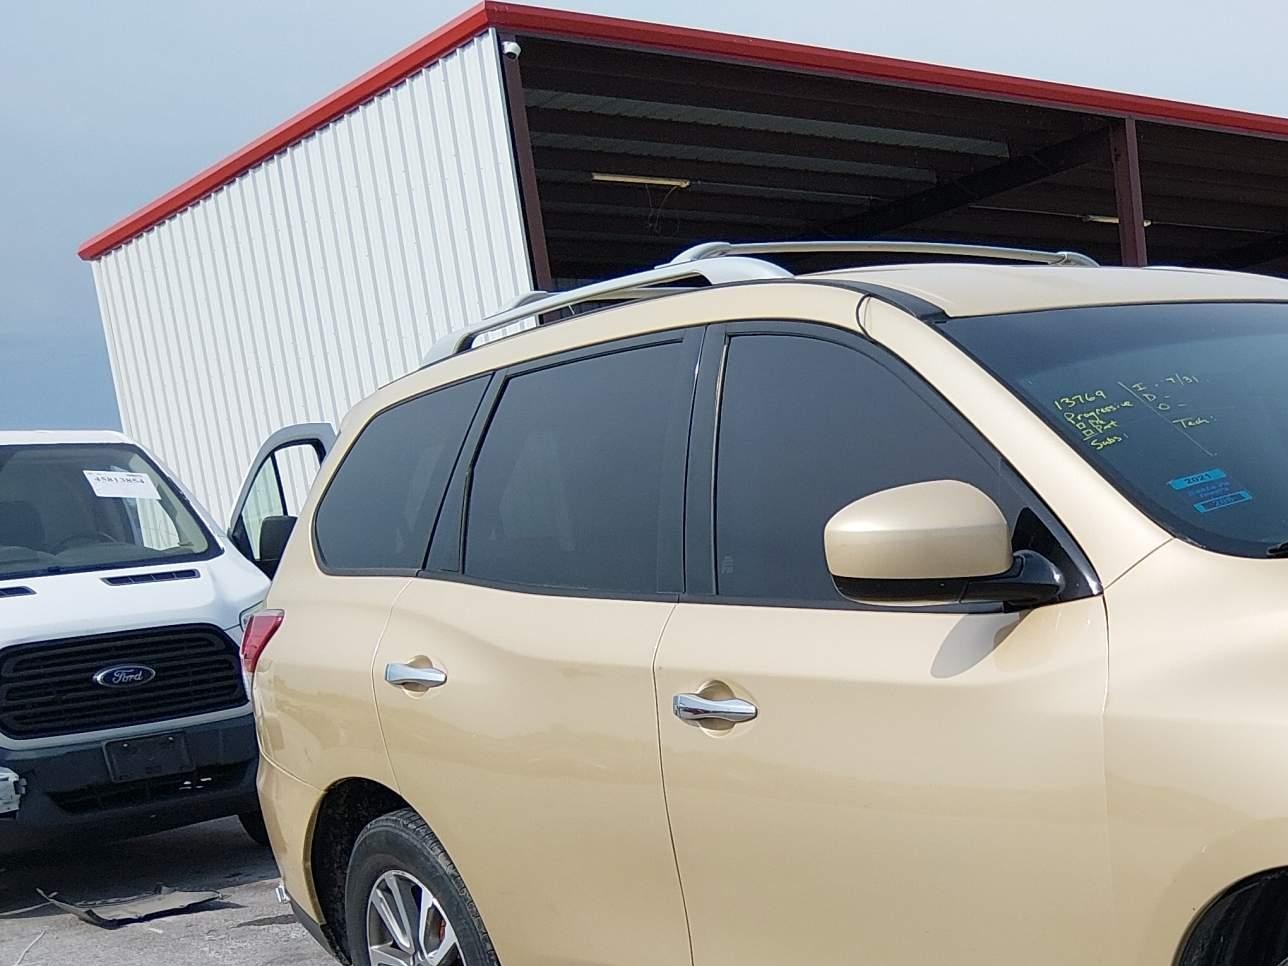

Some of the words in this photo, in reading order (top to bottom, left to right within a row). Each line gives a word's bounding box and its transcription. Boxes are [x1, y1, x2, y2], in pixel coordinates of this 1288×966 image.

[1054, 390, 1107, 410] 13769
[1184, 473, 1212, 485] 2021
[112, 669, 144, 684] Ford
